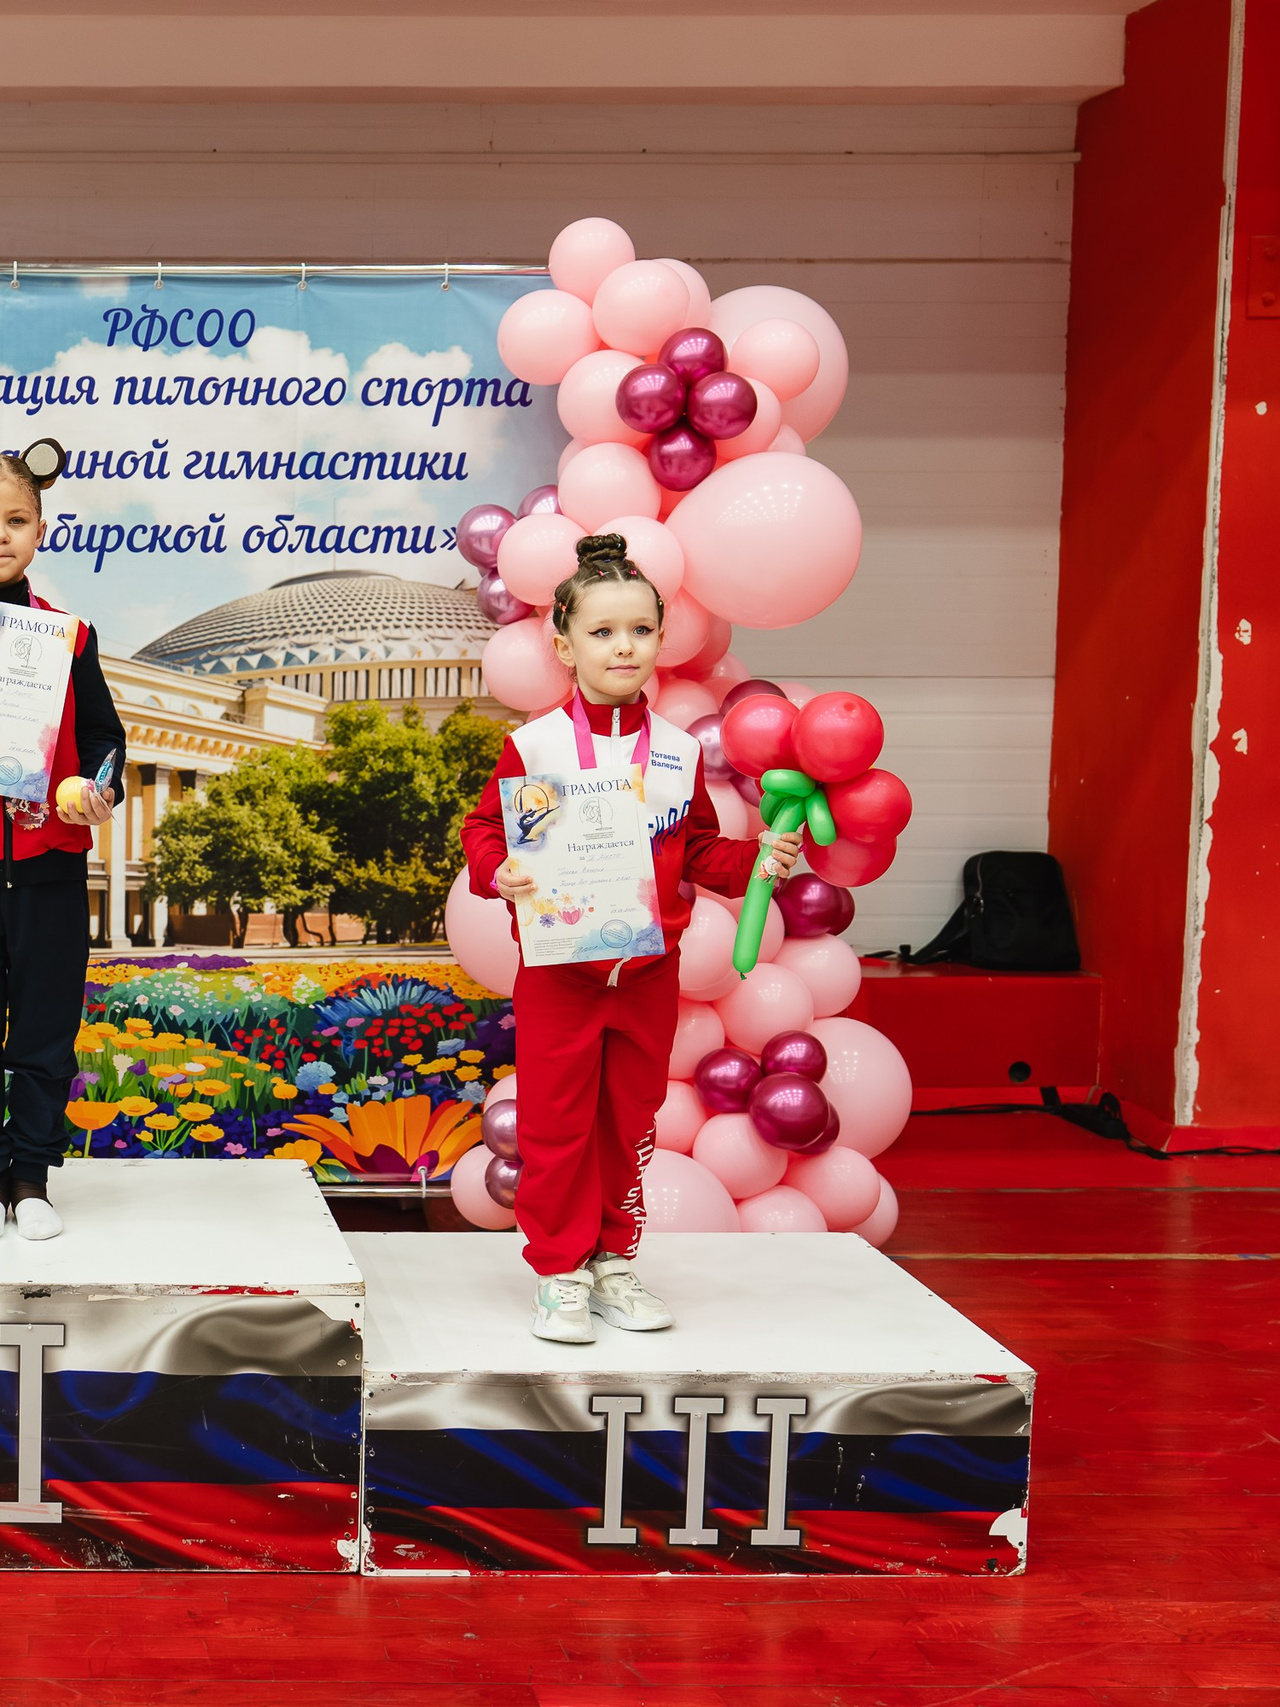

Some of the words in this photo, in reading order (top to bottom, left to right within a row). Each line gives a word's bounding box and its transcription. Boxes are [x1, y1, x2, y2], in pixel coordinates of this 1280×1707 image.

[102, 303, 256, 352] РФСОО
[113, 374, 347, 407] пилонного
[361, 376, 533, 427] спорта
[182, 450, 469, 480] гимнастики
[242, 513, 458, 554] области»
[1, 615, 66, 638] ГРАМОТА
[650, 750, 681, 761] Тотаева
[651, 759, 683, 771] Валерия
[562, 778, 632, 797] ГРАМОТА
[567, 839, 635, 853] Награждается
[587, 1395, 807, 1546] III
